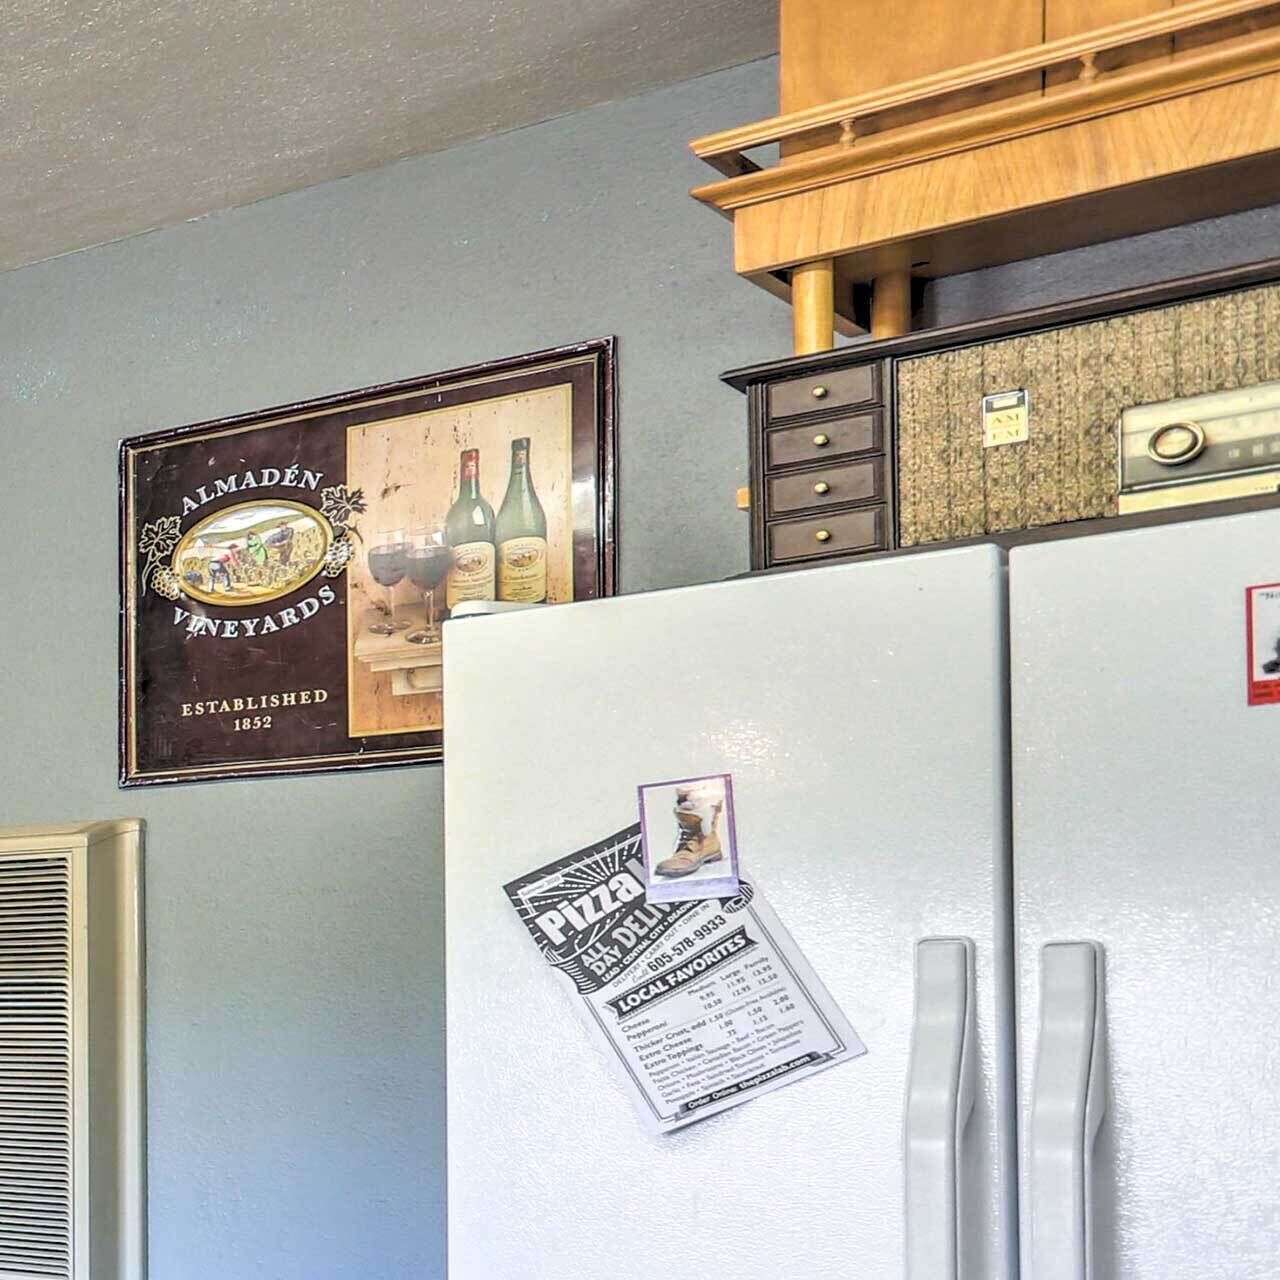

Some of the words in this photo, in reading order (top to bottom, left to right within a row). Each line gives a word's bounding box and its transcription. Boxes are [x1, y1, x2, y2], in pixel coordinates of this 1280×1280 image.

[182, 464, 324, 516] ALMADÉN
[174, 585, 336, 639] VINEYARDS
[181, 689, 329, 717] ESTABLISHED
[233, 715, 273, 732] 1852
[534, 872, 646, 946] Pizza
[663, 926, 679, 942] OUT
[681, 909, 700, 925] DINE
[698, 901, 710, 912] IN
[580, 940, 612, 968] ALL
[600, 964, 621, 983] LEAD
[621, 937, 652, 966] CENTRAL
[648, 922, 665, 940] CITY
[646, 912, 727, 973] 605-578-9933
[589, 943, 623, 976] DAY
[616, 979, 669, 1013] LOCAL
[664, 933, 747, 988] FAVORITES
[620, 1017, 650, 1033] Cheese
[632, 1035, 664, 1053] Thicker
[661, 1035, 692, 1052] Cheese
[686, 1094, 711, 1109] Order
